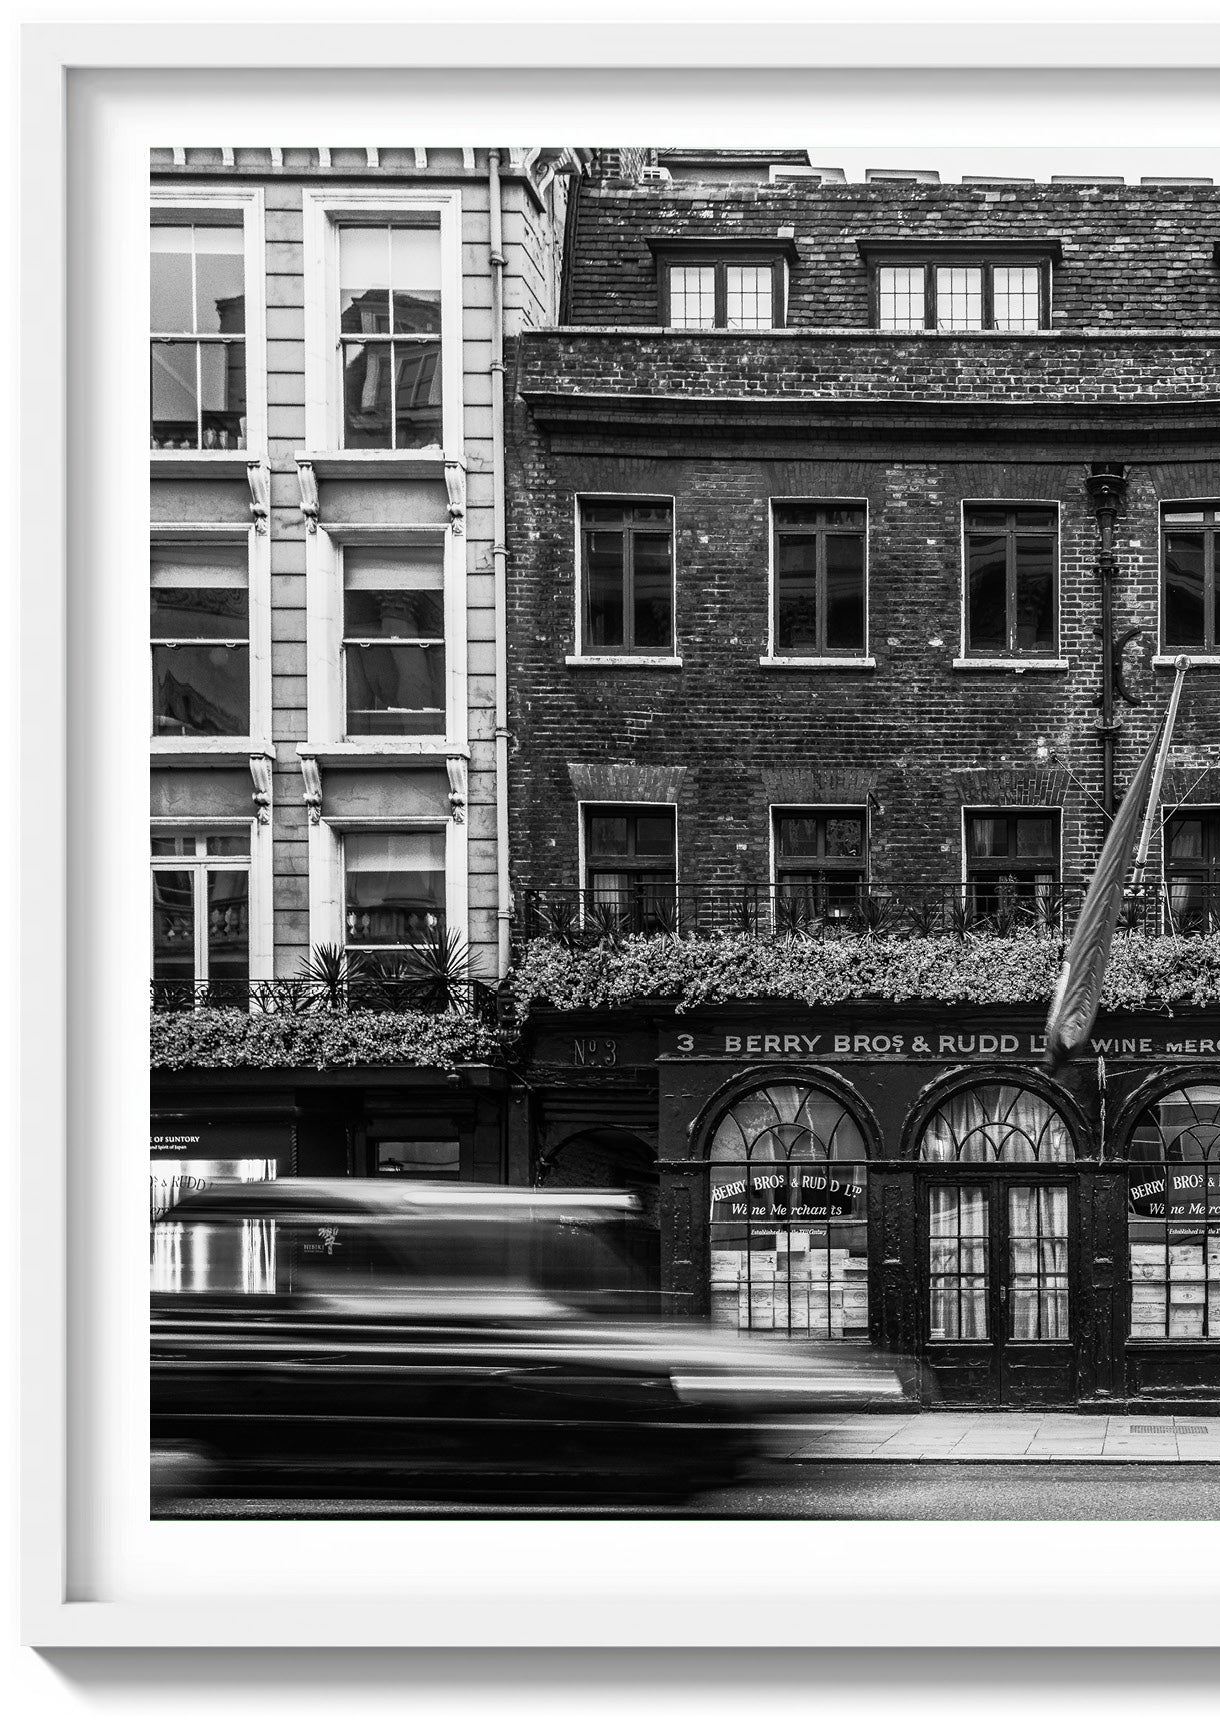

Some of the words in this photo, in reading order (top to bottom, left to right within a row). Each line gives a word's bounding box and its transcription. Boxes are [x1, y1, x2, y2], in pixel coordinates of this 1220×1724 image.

[677, 1033, 695, 1052] 3
[725, 1034, 822, 1053] BERRY
[911, 1035, 932, 1053] &
[939, 1034, 1020, 1053] RUDD
[1090, 1038, 1153, 1053] WINE
[604, 1039, 617, 1067] 3
[165, 1135, 200, 1143] SUNTORY
[172, 1175, 206, 1191] RUDD
[712, 1179, 746, 1202] BERRY
[791, 1178, 799, 1188] &
[802, 1175, 840, 1193] RUDD
[1130, 1178, 1165, 1201] BERRY
[1207, 1177, 1215, 1187] &
[732, 1203, 767, 1216] Wine
[770, 1203, 843, 1216] Merchants
[1149, 1202, 1185, 1215] Wine
